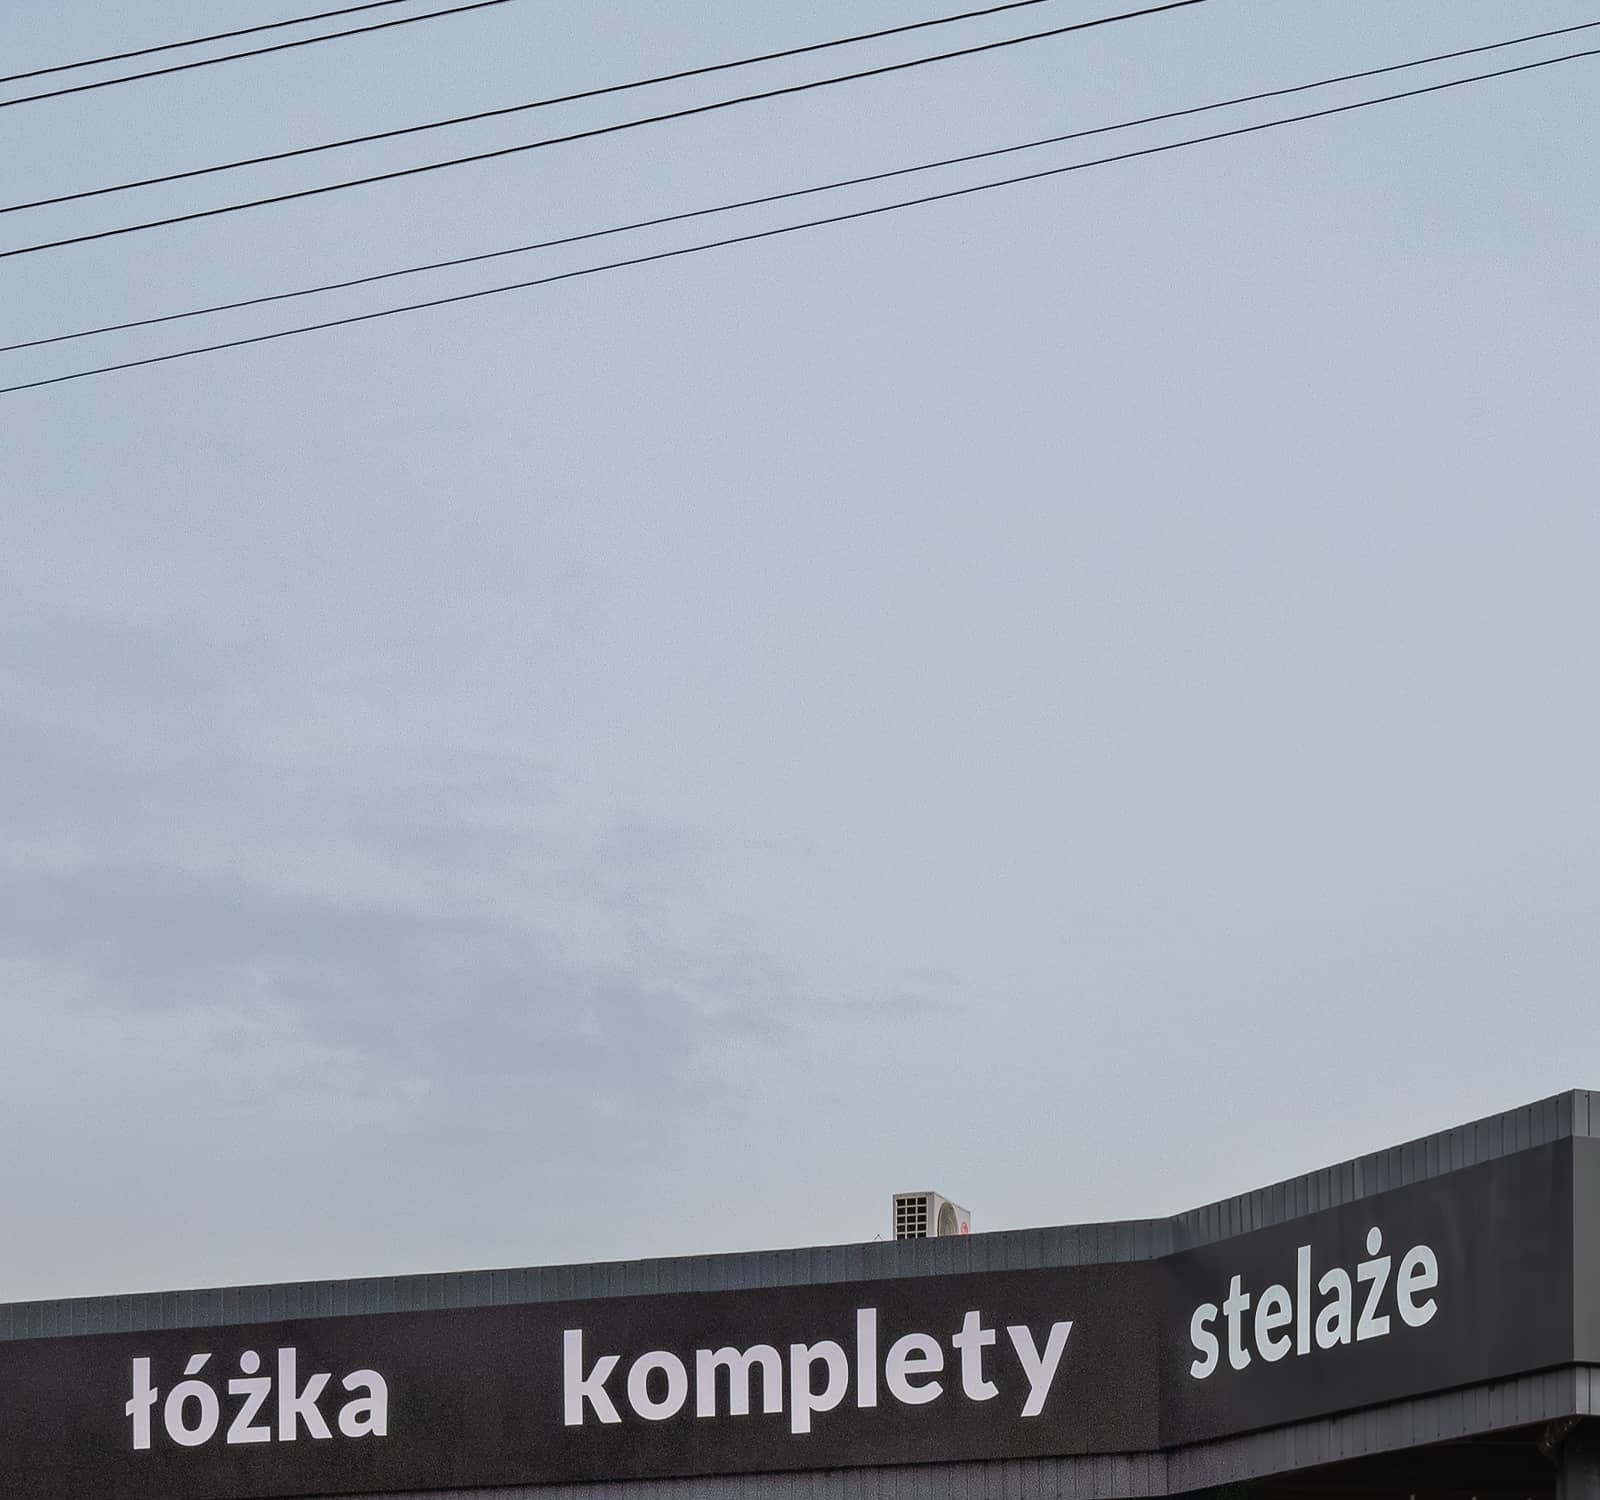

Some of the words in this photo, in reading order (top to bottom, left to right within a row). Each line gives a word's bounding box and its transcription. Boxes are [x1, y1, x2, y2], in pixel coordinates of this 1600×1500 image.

[1190, 1227, 1438, 1379] stelaże
[126, 1347, 388, 1449] łóżka
[564, 1308, 1073, 1434] komplety
